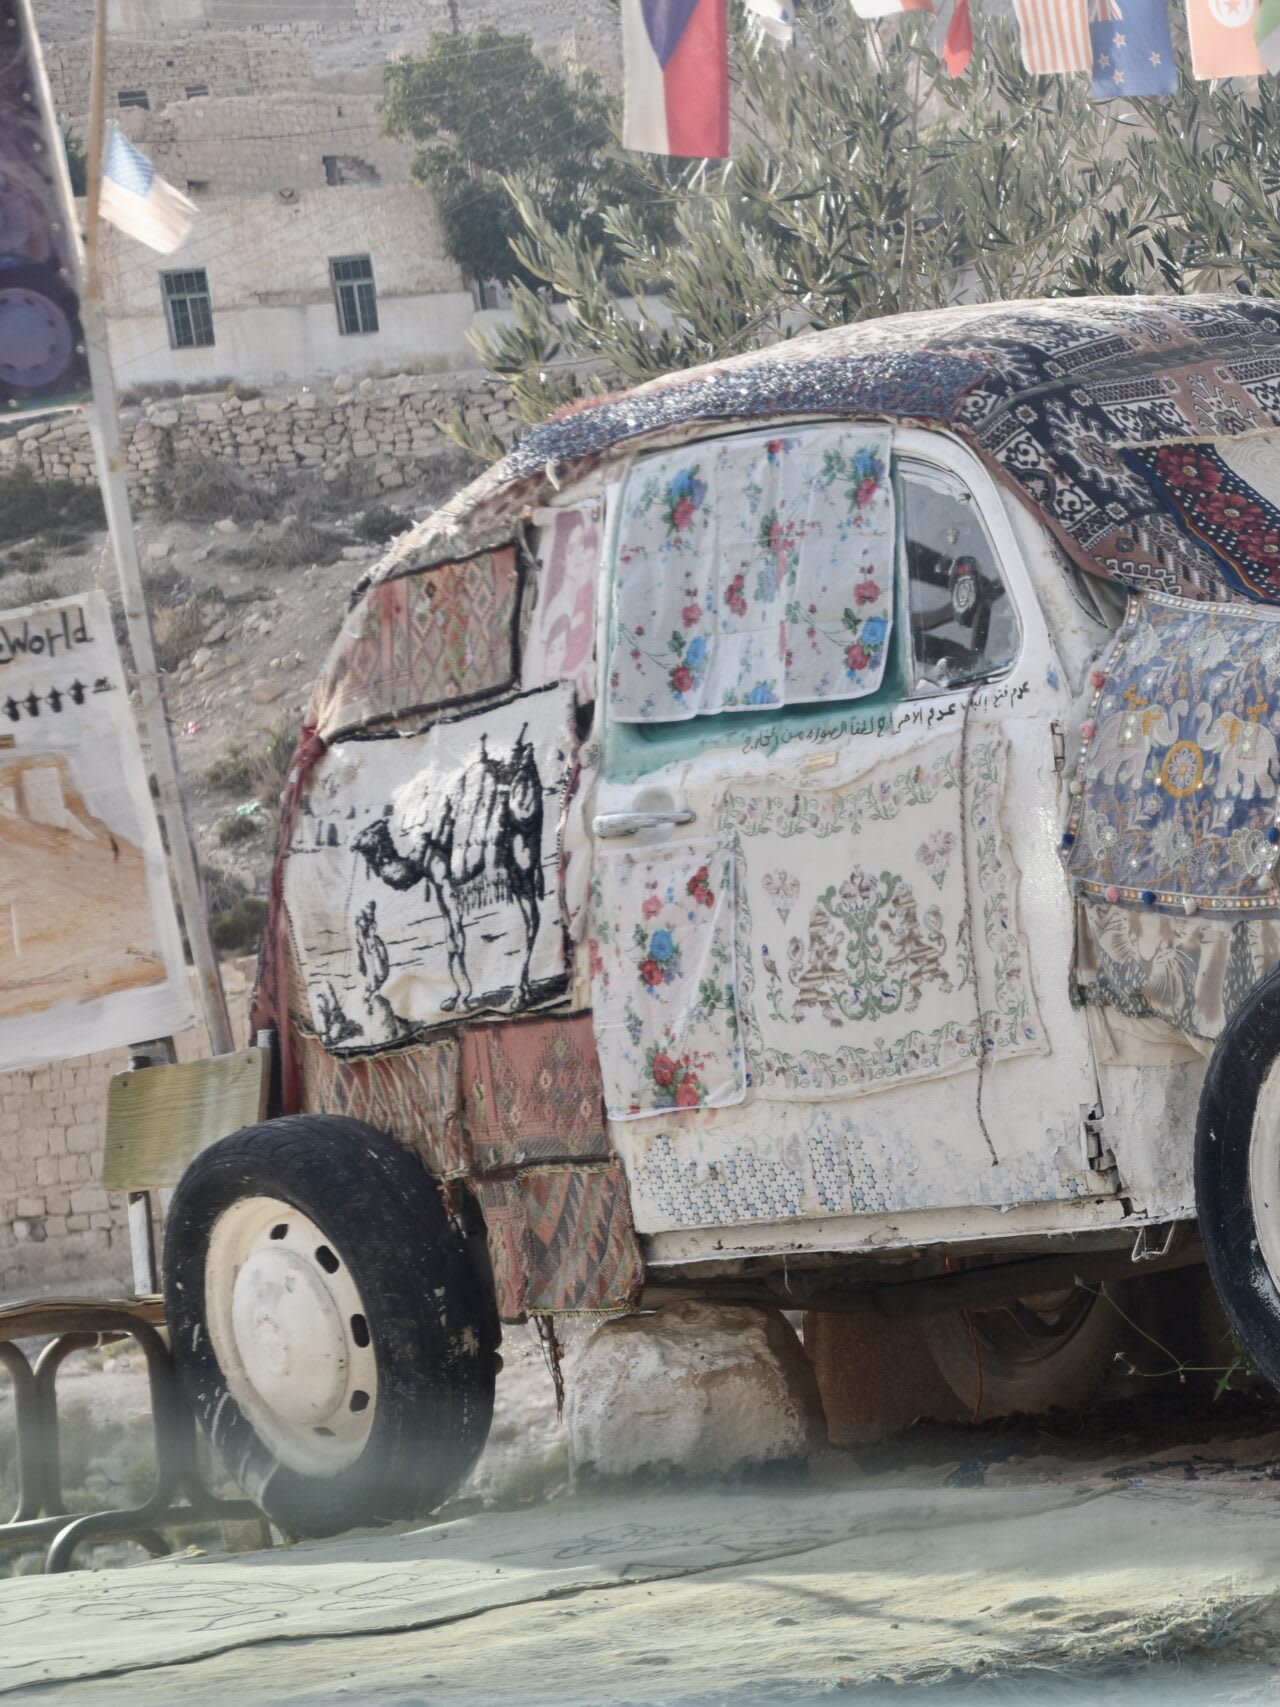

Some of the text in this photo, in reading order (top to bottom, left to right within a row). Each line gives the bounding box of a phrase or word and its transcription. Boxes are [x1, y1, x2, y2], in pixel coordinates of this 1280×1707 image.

[0, 607, 96, 658] World
[993, 684, 1009, 709] فتح
[1010, 680, 1031, 709] عدم
[927, 702, 957, 727] عدم
[781, 728, 804, 744] من
